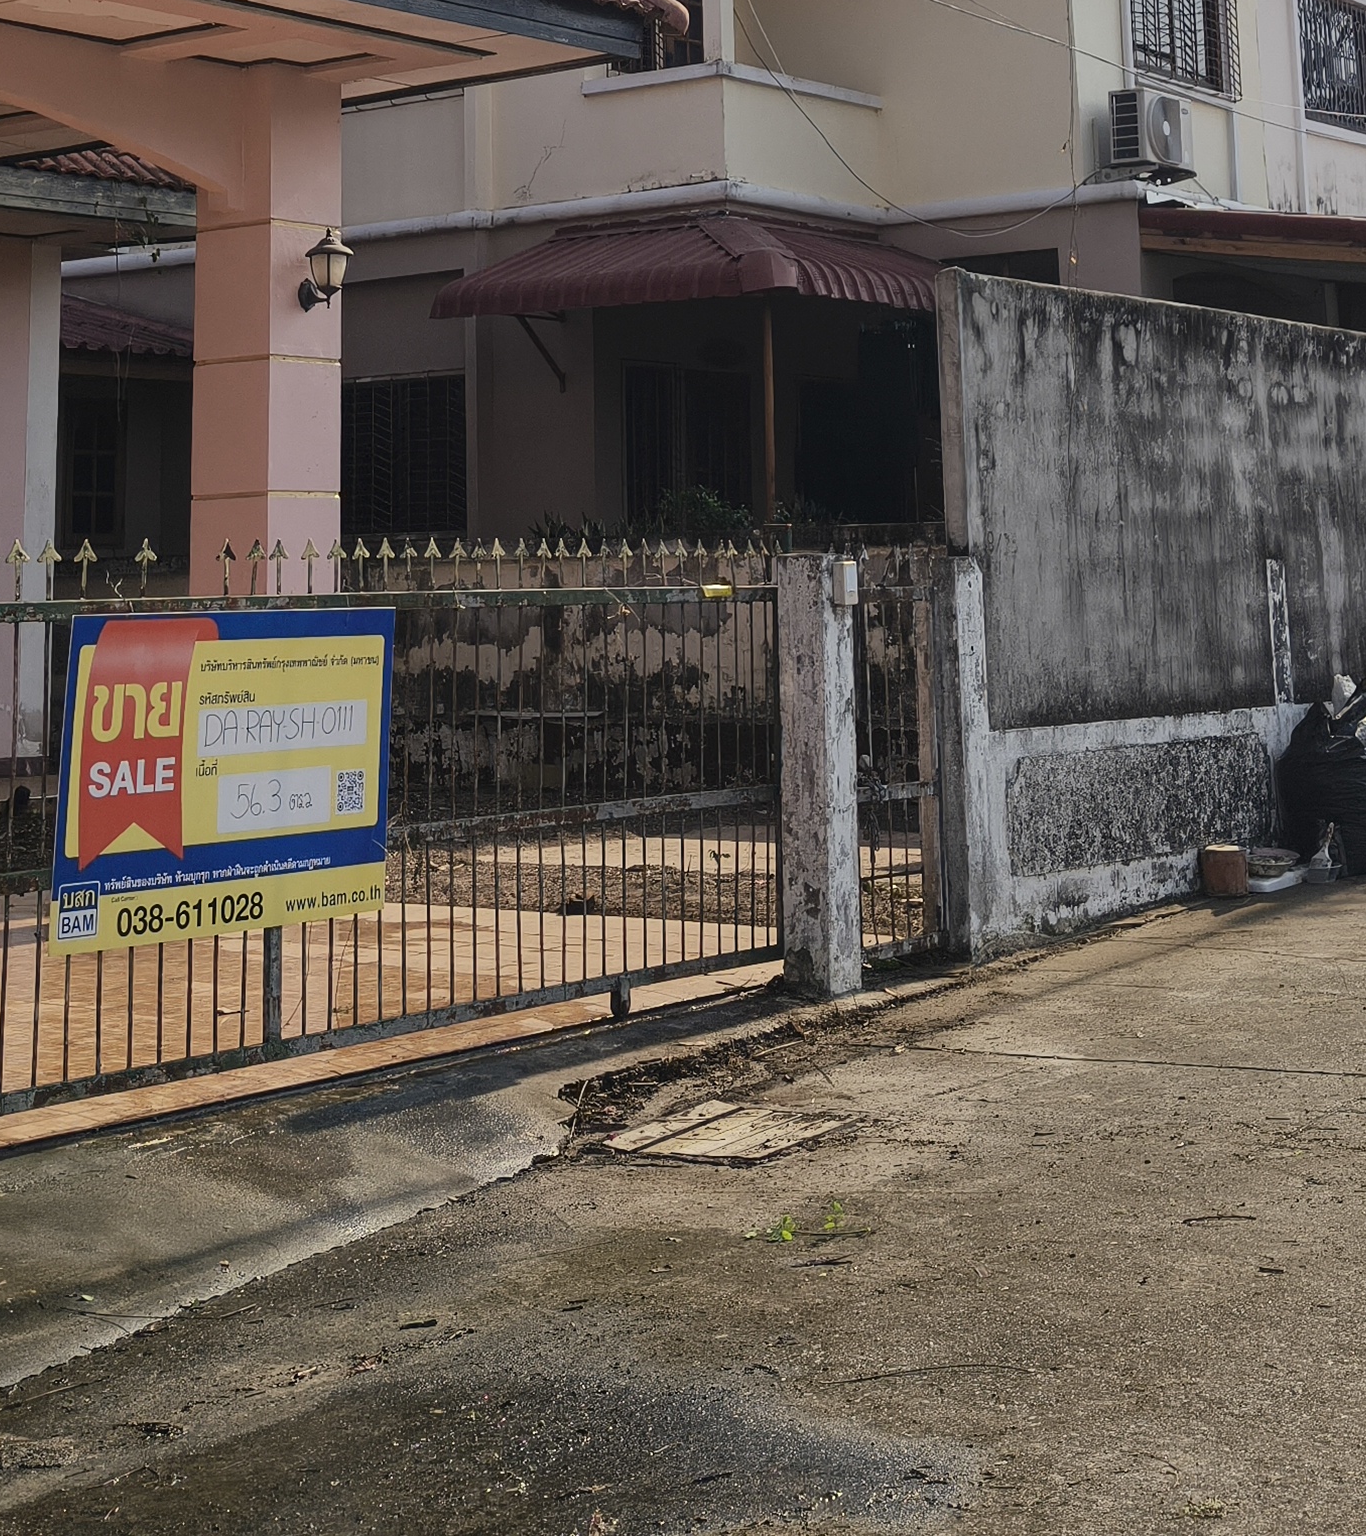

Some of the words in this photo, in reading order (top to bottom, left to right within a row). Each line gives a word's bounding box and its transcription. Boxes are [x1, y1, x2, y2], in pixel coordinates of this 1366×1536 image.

[91, 681, 183, 742] ขาย
[198, 690, 256, 705] รหัสทรัพย์สิน
[88, 757, 176, 798] SALE
[195, 759, 219, 777] เนื้อที่
[230, 779, 282, 819] 56.3
[62, 888, 96, 909] บสก
[117, 891, 264, 937] 038-611028
[286, 884, 381, 912] www.bam.co.th
[61, 914, 94, 934] BAM
